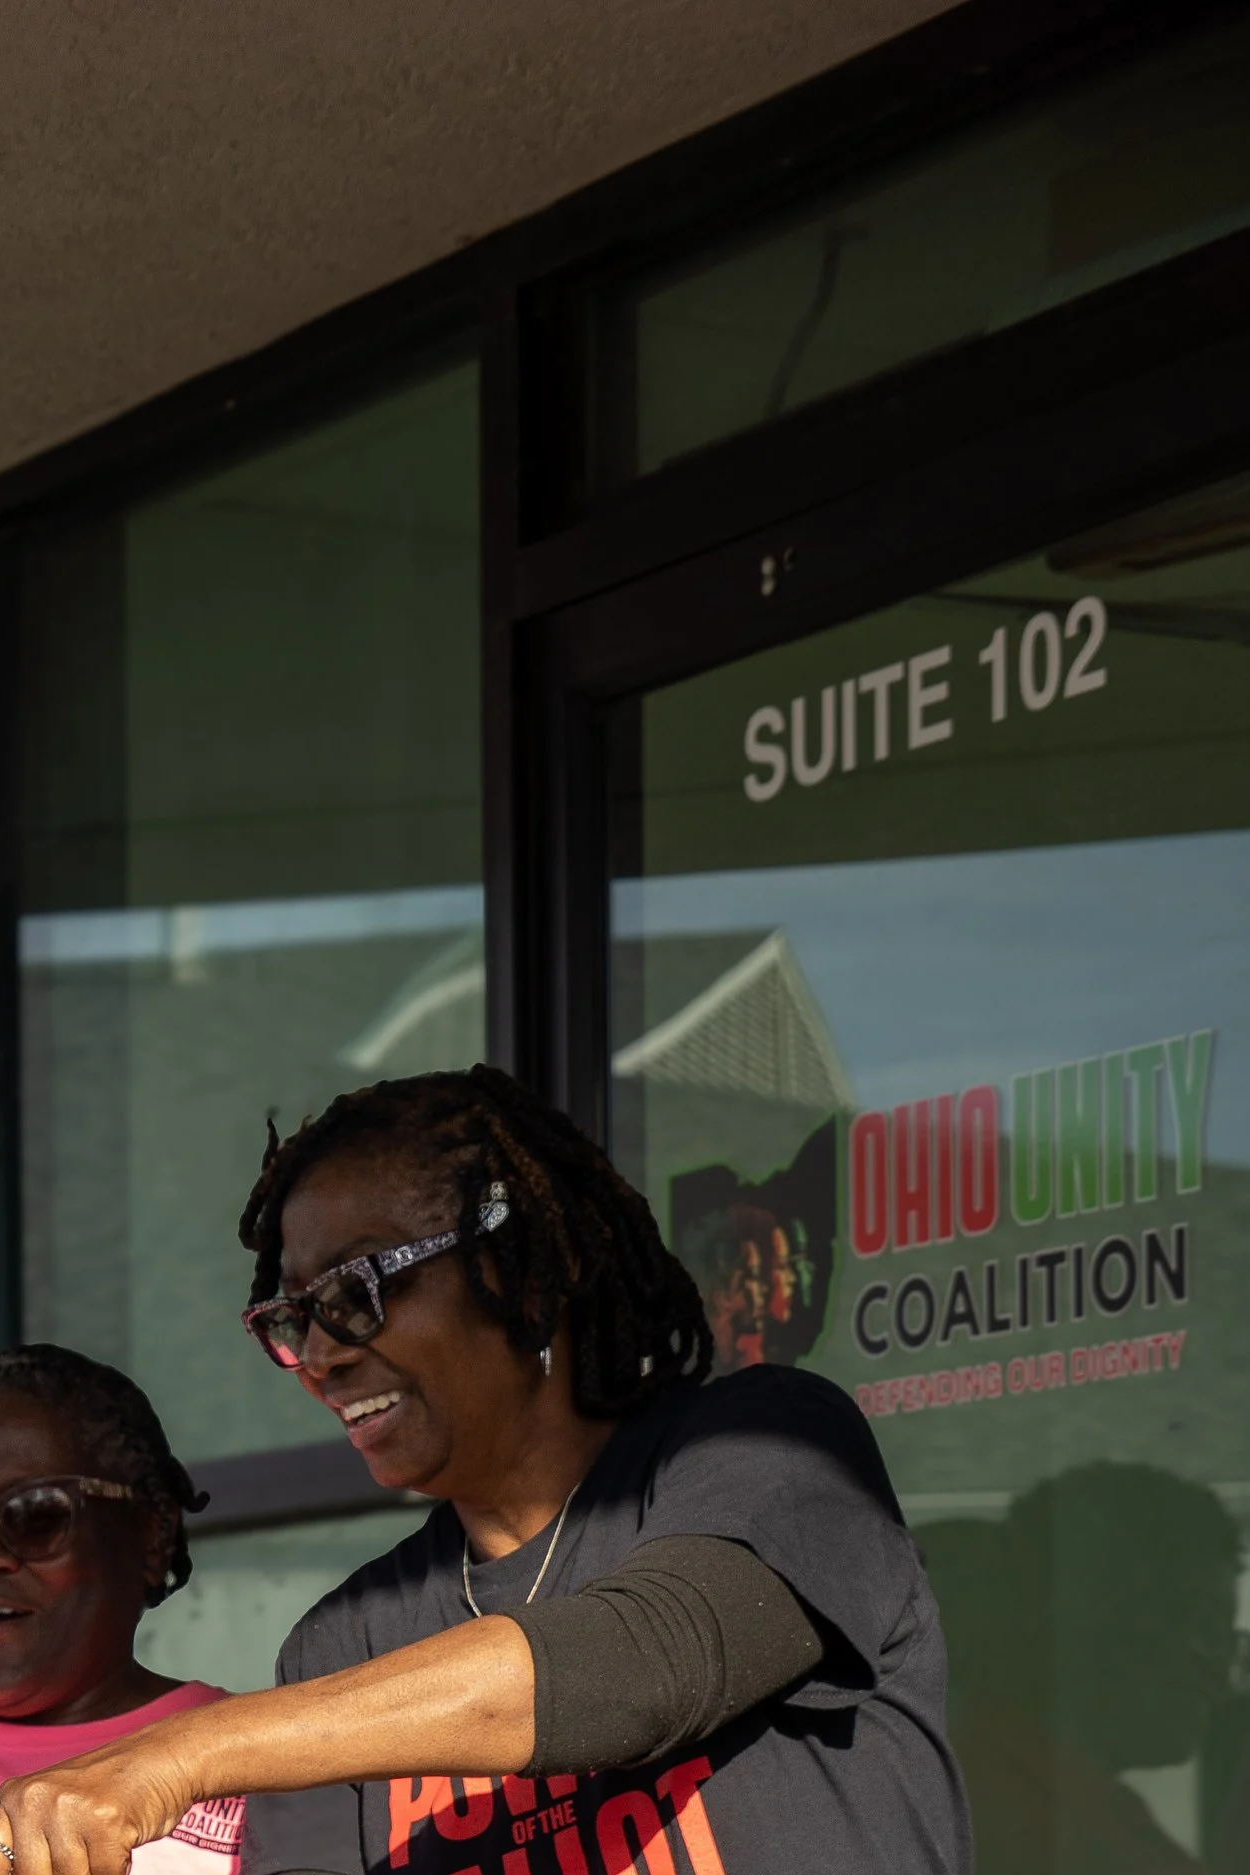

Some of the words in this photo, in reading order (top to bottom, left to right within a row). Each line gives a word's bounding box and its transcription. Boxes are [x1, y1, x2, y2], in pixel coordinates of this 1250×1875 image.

[743, 643, 954, 802] SUITE
[978, 596, 1108, 723] 102
[851, 1083, 999, 1258] OHIO
[1009, 1028, 1214, 1226] UNITY
[853, 1223, 1189, 1356] COALITION
[854, 1359, 1002, 1417] DEFENDING
[1005, 1352, 1066, 1394] OUR
[1069, 1330, 1186, 1383] DIGNITY
[511, 1816, 537, 1845] OF
[536, 1800, 578, 1835] THE
